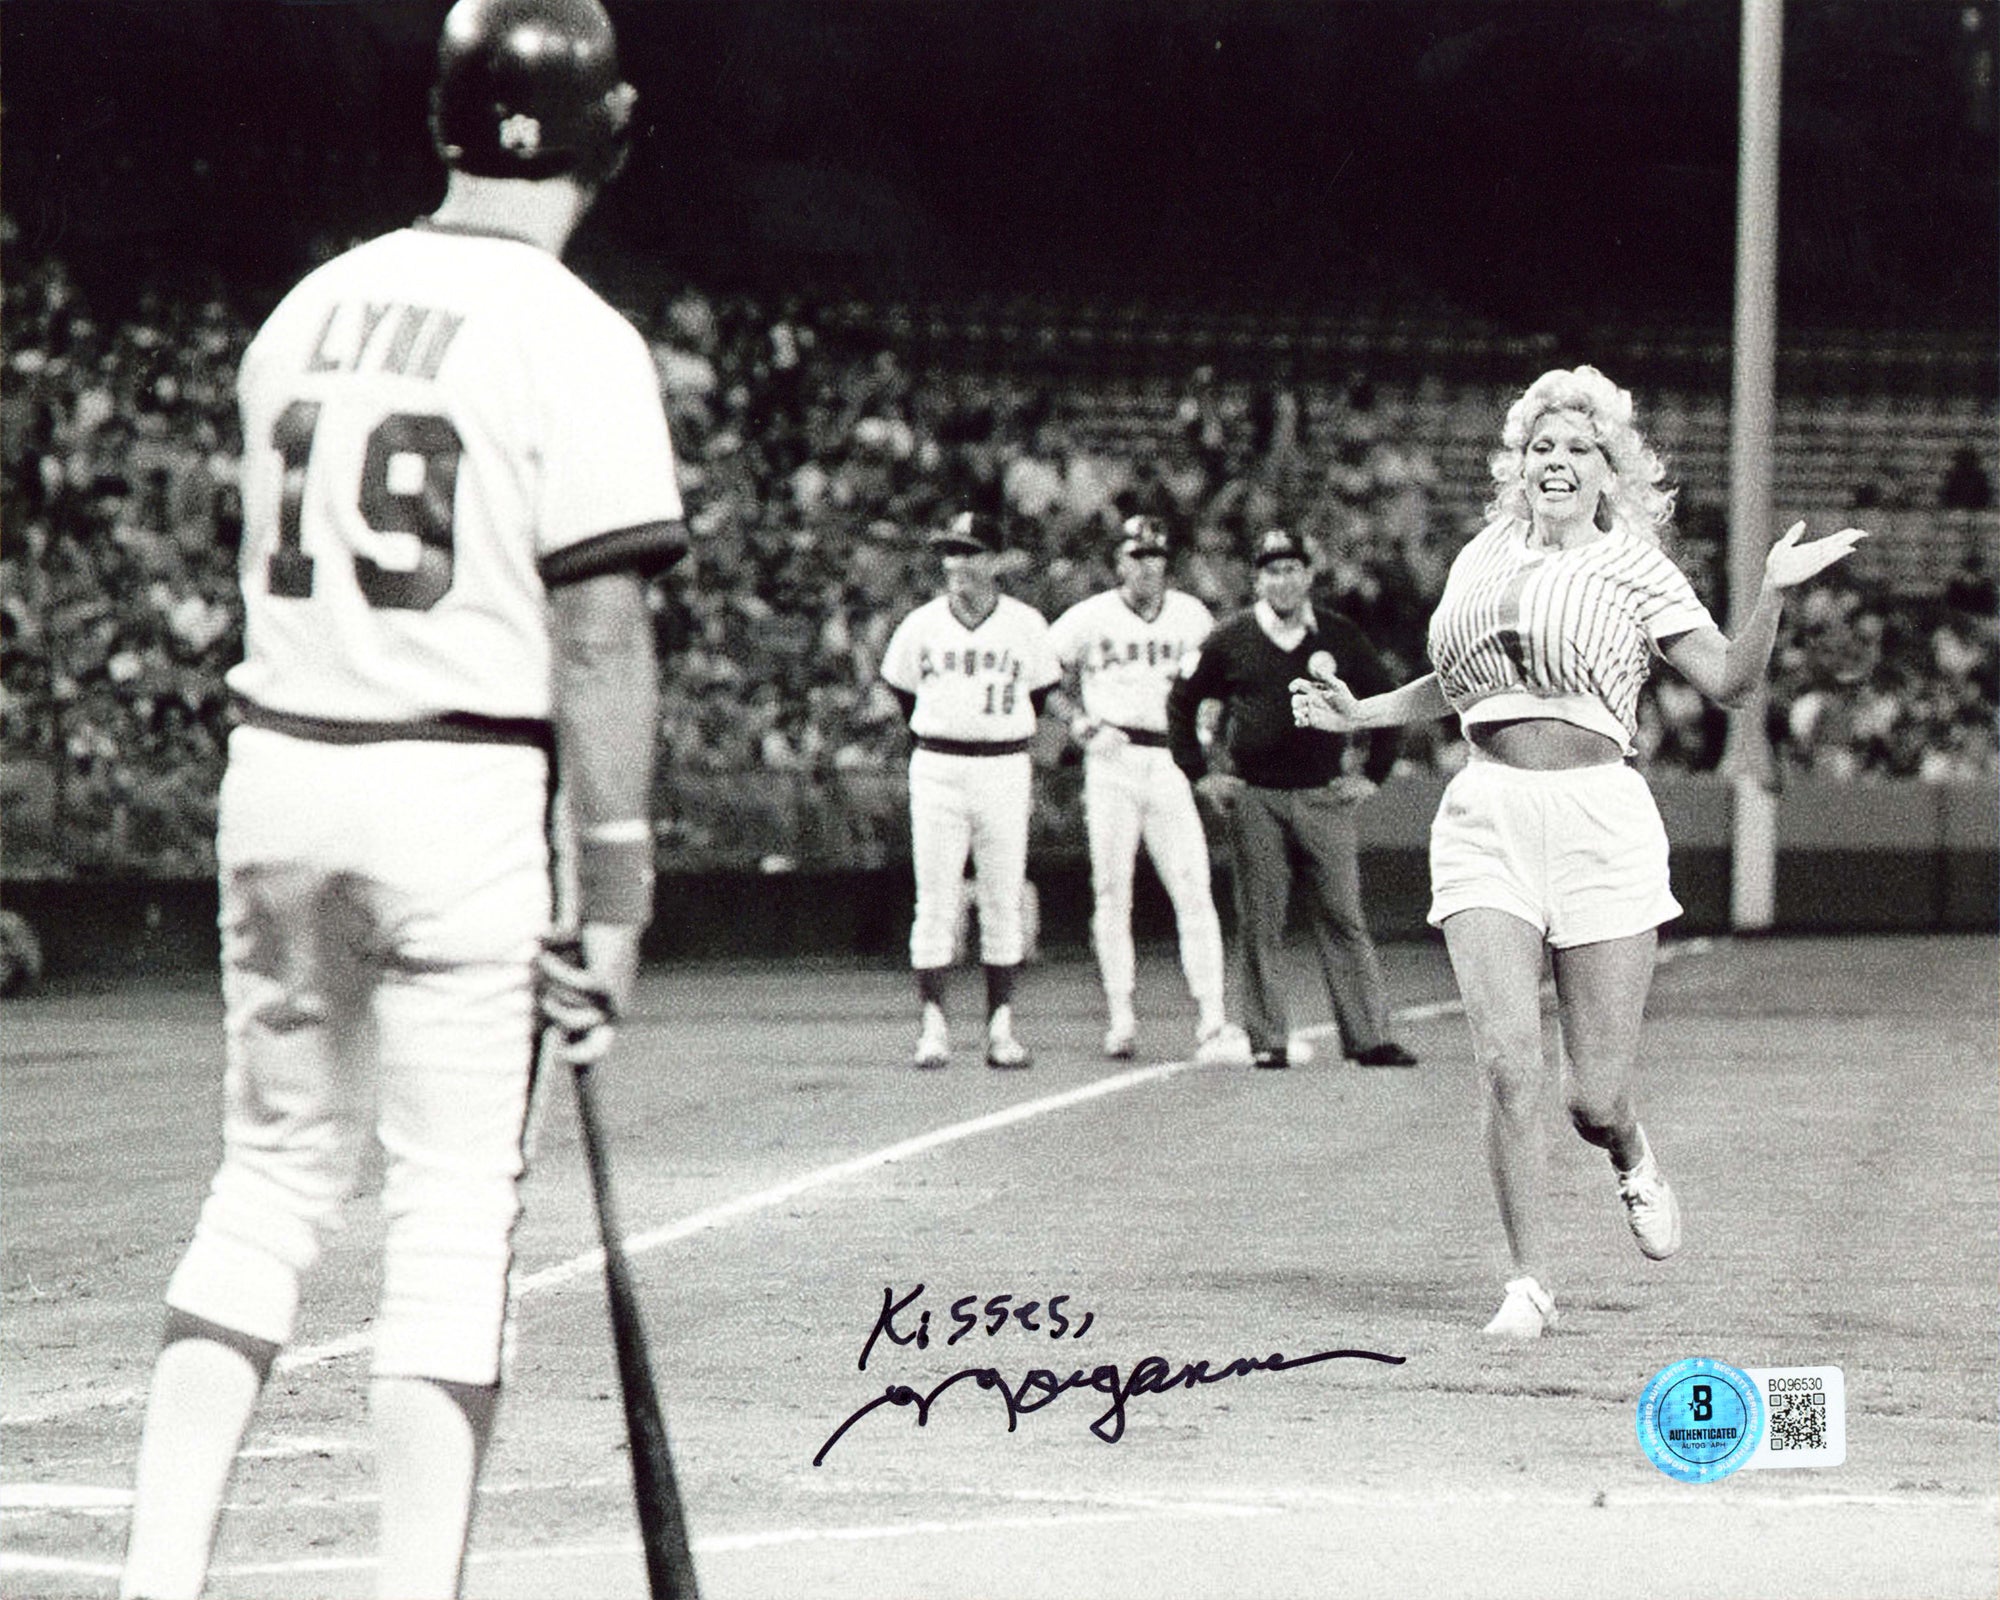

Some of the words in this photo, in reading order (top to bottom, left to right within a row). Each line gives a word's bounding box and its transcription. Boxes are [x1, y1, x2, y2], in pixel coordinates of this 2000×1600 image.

[305, 302, 465, 381] LYNN
[267, 400, 464, 612] 19
[1692, 1385, 1713, 1421] B
[1768, 1378, 1823, 1392] BQ96530
[1669, 1428, 1737, 1441] AUTHENTICATED
